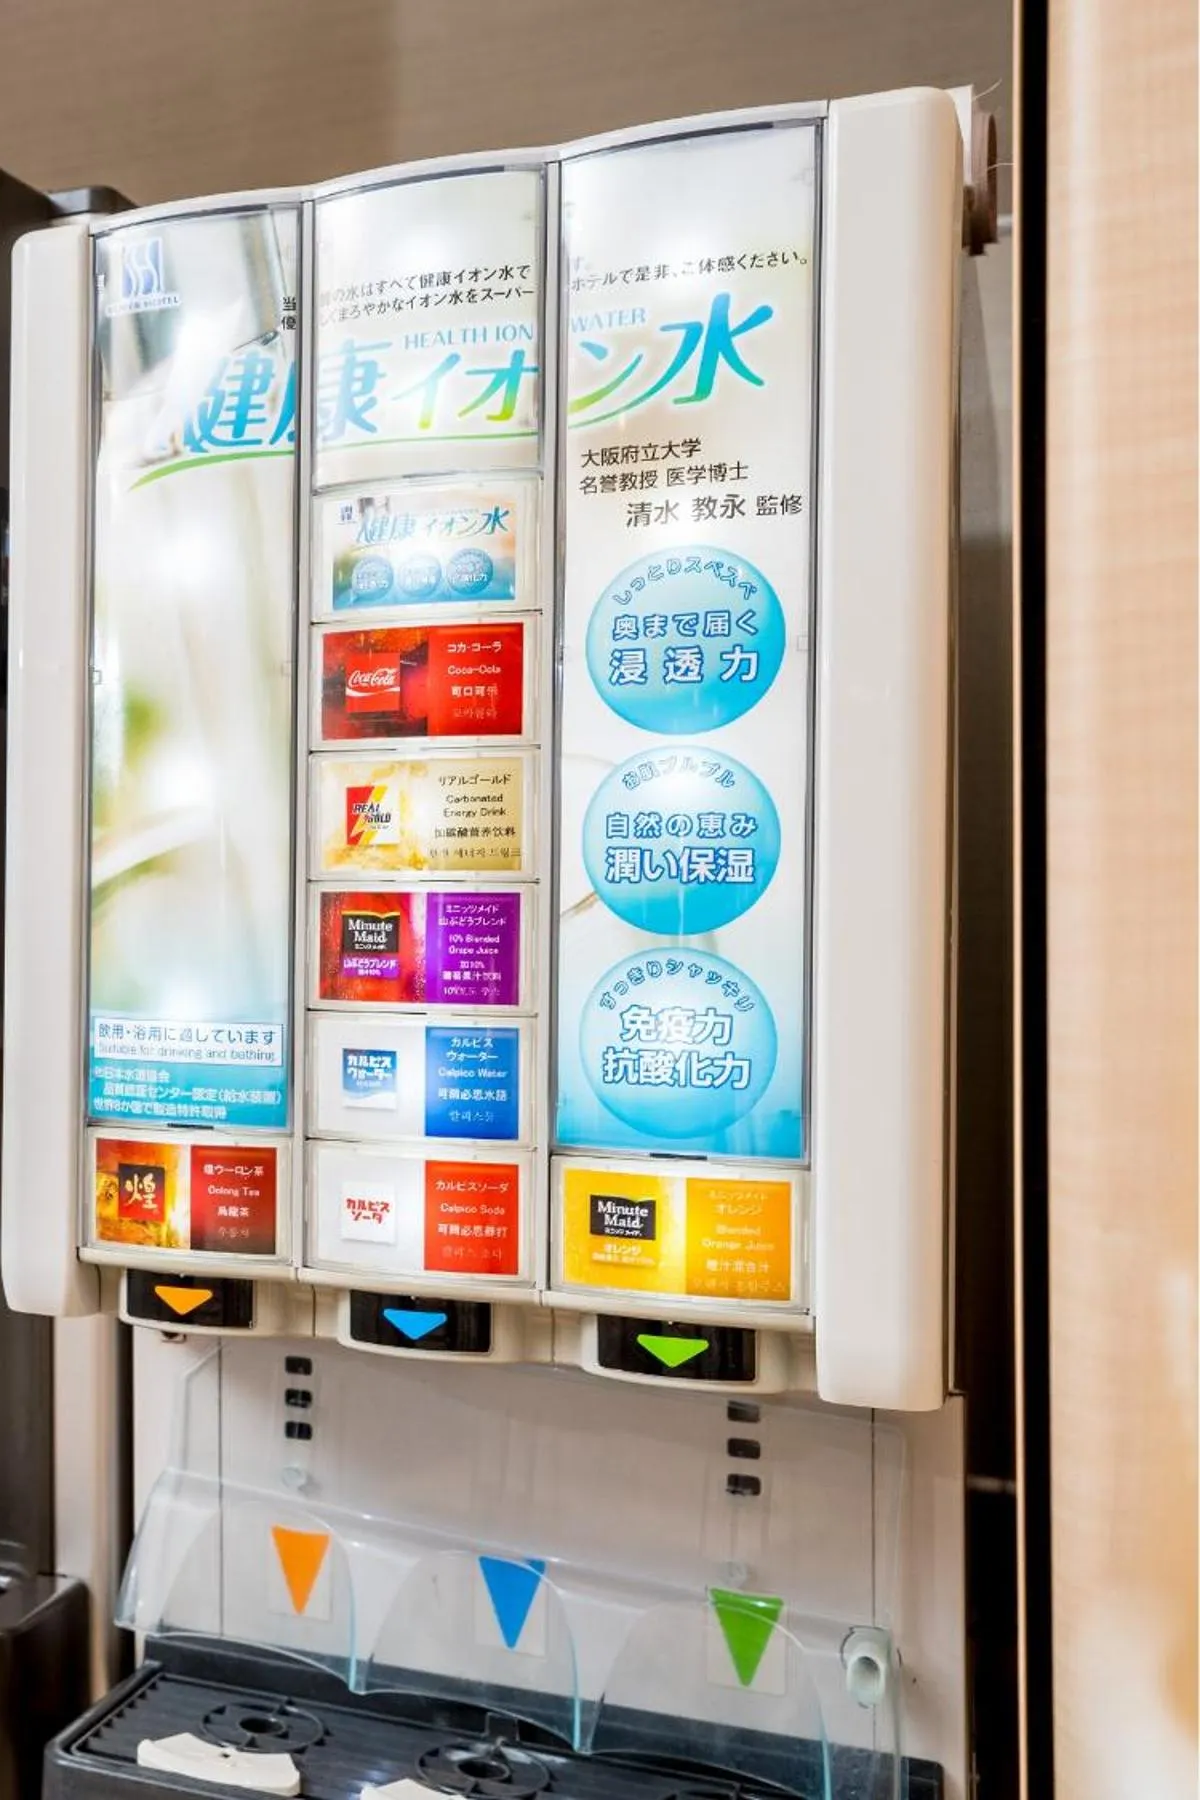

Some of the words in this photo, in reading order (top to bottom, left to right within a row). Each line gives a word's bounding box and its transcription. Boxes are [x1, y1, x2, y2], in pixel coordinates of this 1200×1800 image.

[404, 325, 487, 350] HEALTH
[495, 323, 534, 342] ION
[570, 306, 647, 334] WATER
[580, 437, 702, 468] 大阪府立大学
[579, 469, 659, 495] 名誉教授
[666, 461, 749, 487] 医学博士
[626, 498, 680, 528] 清水
[691, 493, 746, 522] 教永
[755, 493, 804, 516] 監修
[612, 609, 759, 642] 奥まで届く
[447, 642, 502, 654] コカ・コーラ
[447, 665, 502, 676] Coca-Cola
[610, 644, 760, 686] 浸透力
[438, 773, 512, 786] リアルゴールド
[446, 793, 504, 804] Carbonated
[443, 807, 478, 819] Energy
[479, 806, 506, 817] Drink
[606, 811, 759, 839] 自然の恵み
[605, 845, 756, 885] 潤い保湿
[348, 918, 393, 933] Minute
[353, 931, 388, 944] Maid
[476, 945, 500, 955] Juice
[619, 1004, 734, 1046] 免疫力
[98, 1023, 276, 1045] 飲用・浴用に適しています
[451, 1036, 494, 1049] カルピス
[347, 1055, 393, 1068] カルピス
[602, 1046, 751, 1090] 抗酸化力
[124, 1172, 158, 1210] 煌
[207, 1185, 240, 1198] Oolong
[242, 1186, 261, 1197] Tea
[435, 1179, 510, 1195] カルピスソーダ
[346, 1197, 391, 1213] カルピス
[479, 1204, 506, 1216] Soda
[597, 1201, 649, 1218] Minute
[604, 1214, 644, 1229] Maid
